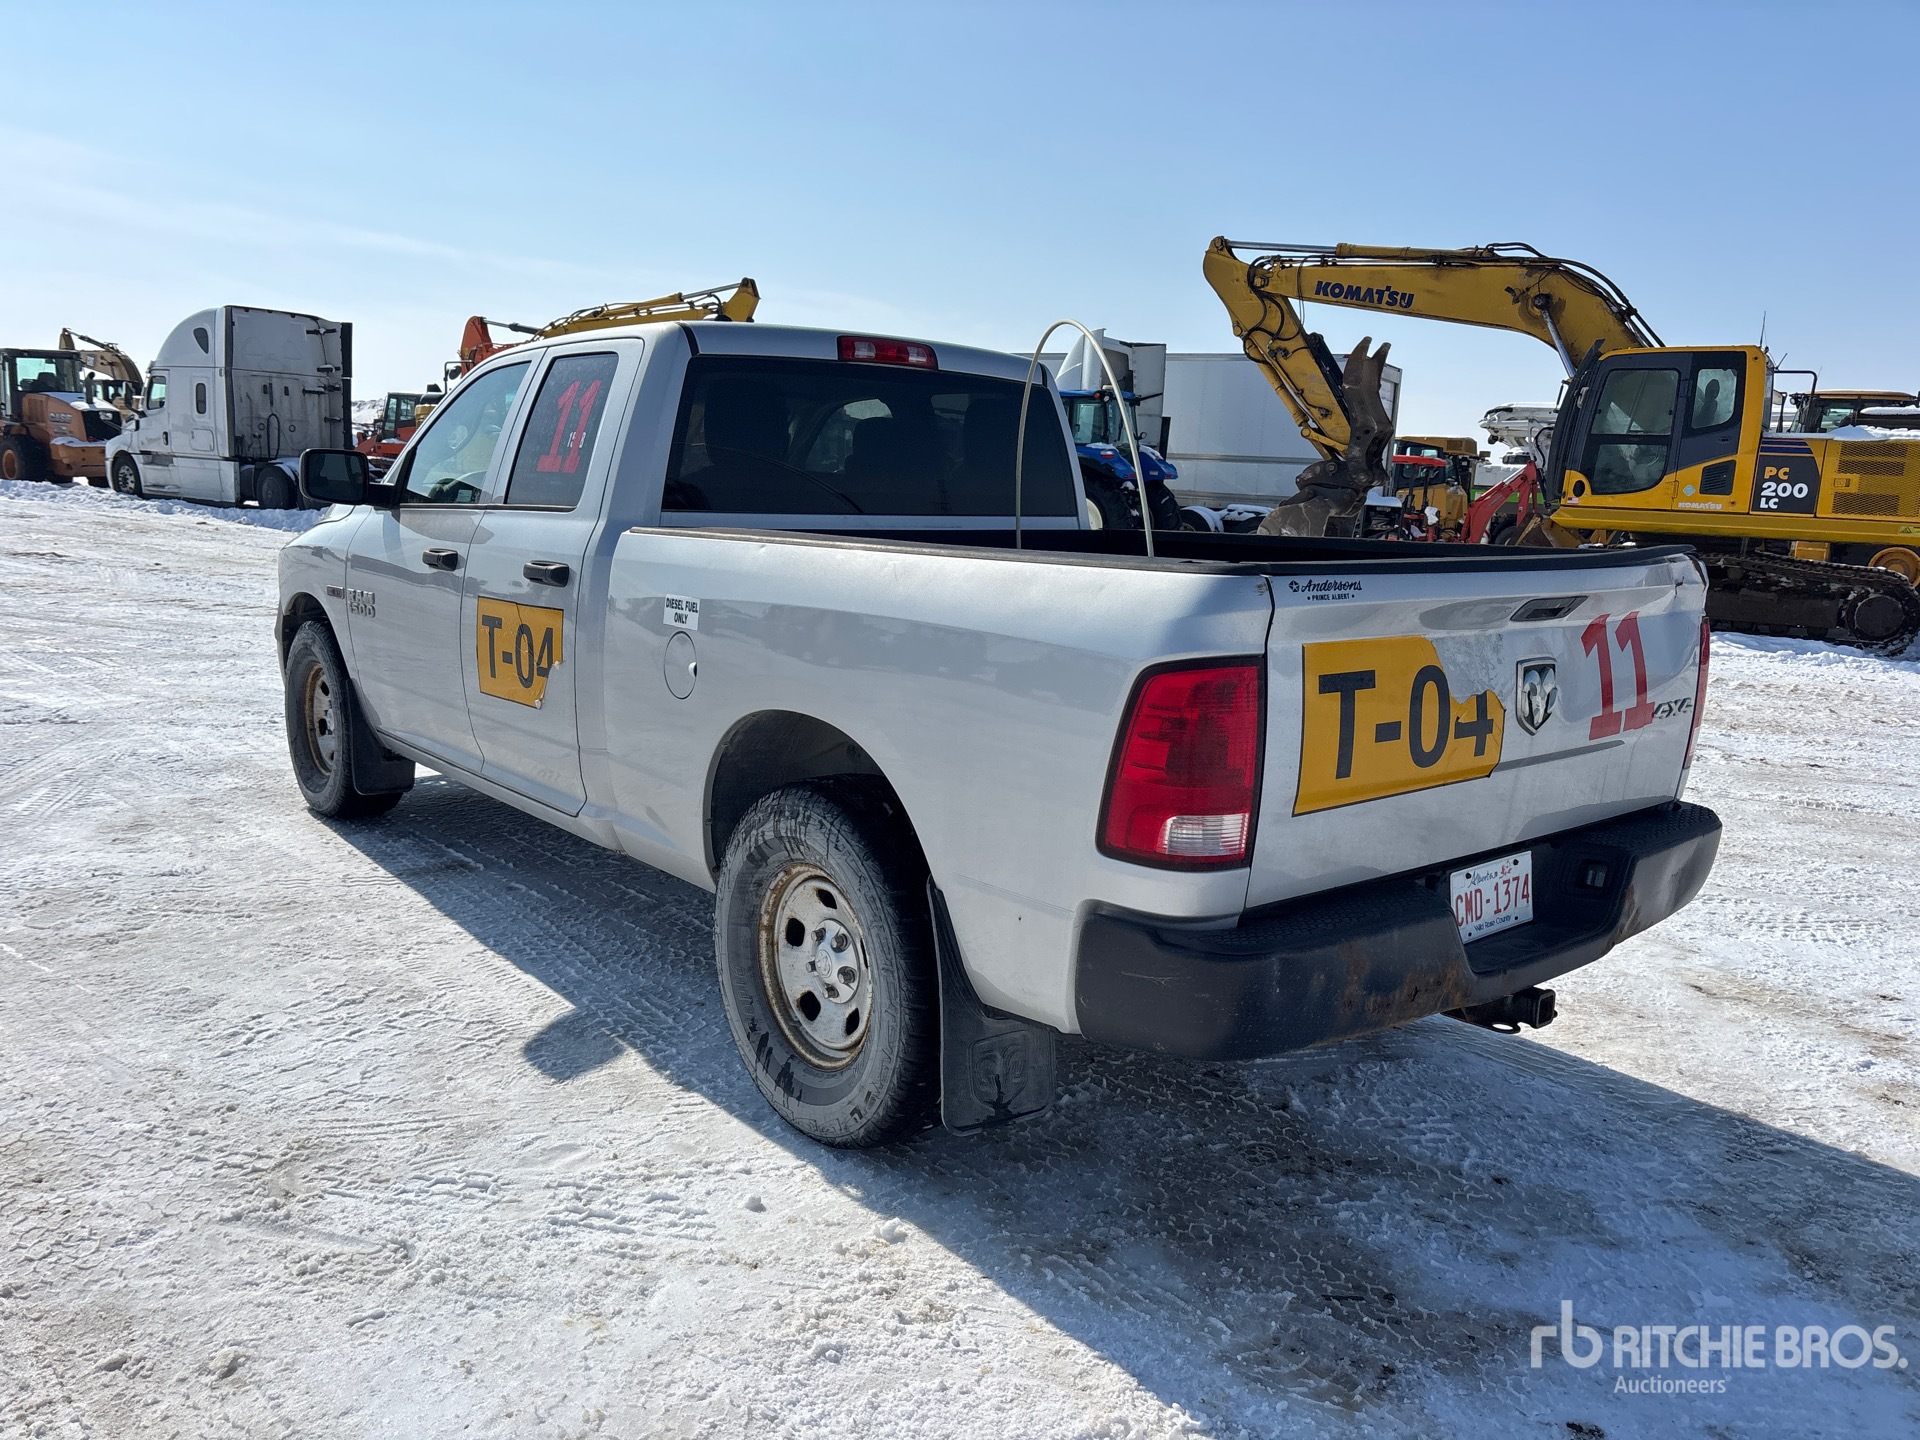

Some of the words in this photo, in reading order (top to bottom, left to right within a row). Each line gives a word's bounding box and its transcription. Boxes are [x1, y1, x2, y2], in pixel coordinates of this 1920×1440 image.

[1314, 280, 1415, 309] KOMATSU
[536, 379, 602, 474] 11
[1763, 466, 1790, 480] PC
[1760, 481, 1809, 499] 200
[1759, 498, 1779, 509] LC
[1301, 579, 1363, 593] Andersons
[665, 597, 684, 611] DIESEL
[684, 600, 699, 613] FUEL
[1331, 593, 1350, 601] ALBERT
[674, 612, 688, 625] ONLY
[481, 614, 554, 689] T-04
[1580, 611, 1656, 741] 11
[1455, 873, 1530, 927] CMD-1374
